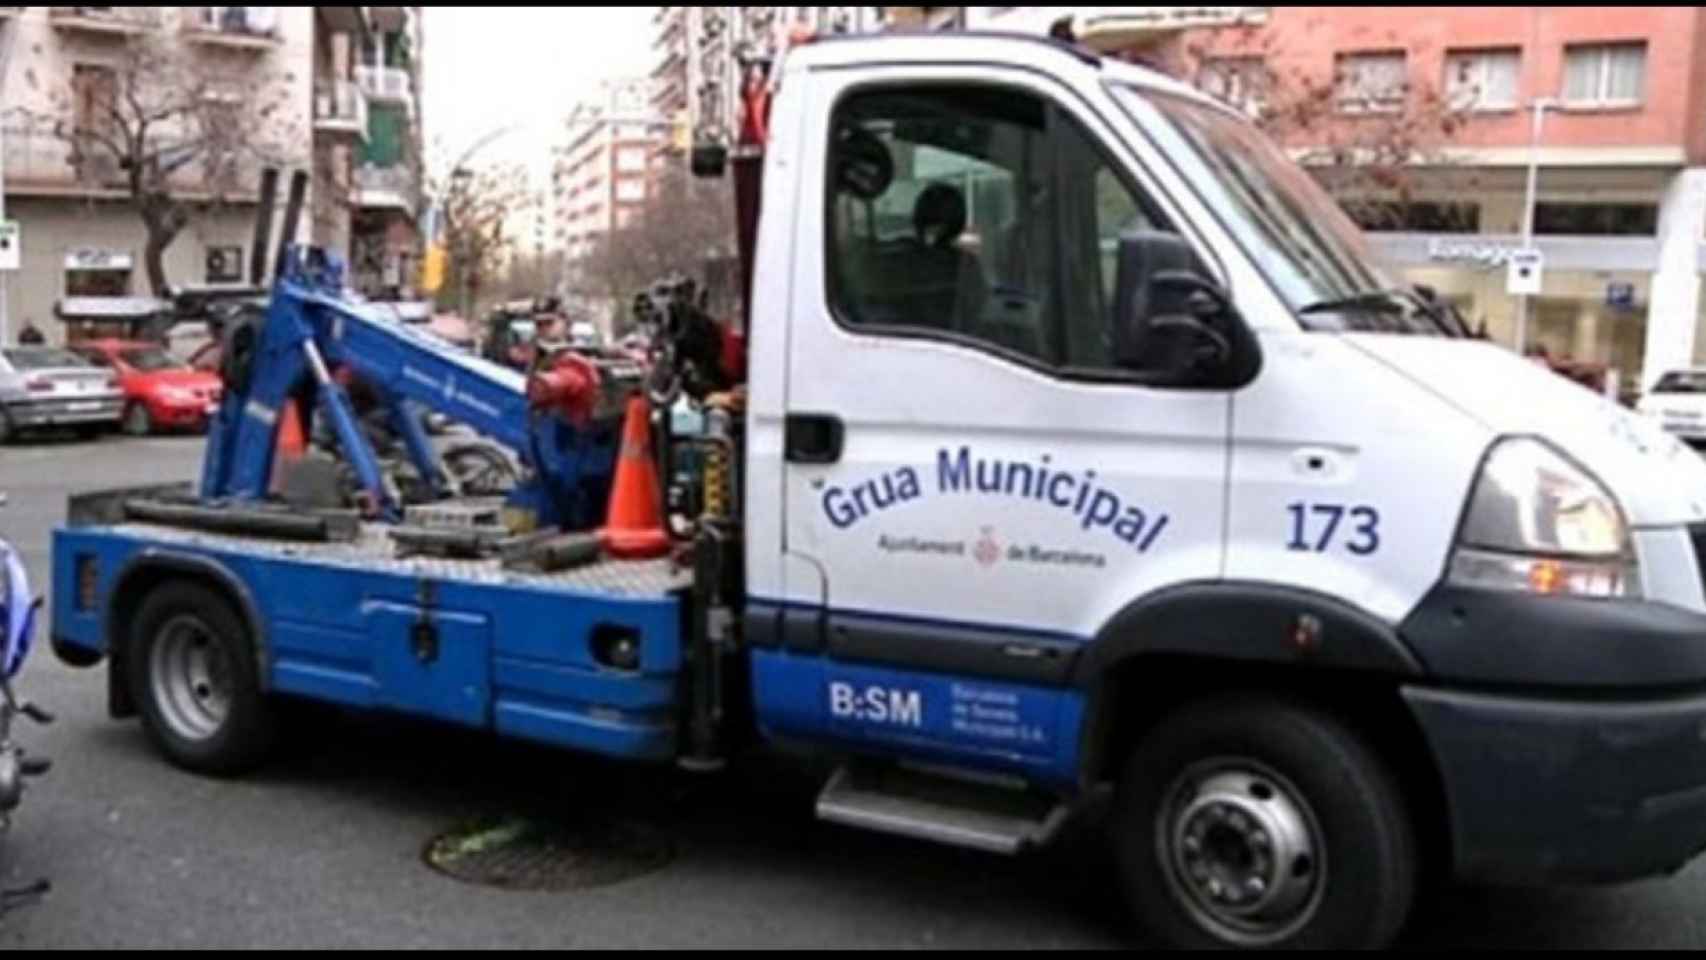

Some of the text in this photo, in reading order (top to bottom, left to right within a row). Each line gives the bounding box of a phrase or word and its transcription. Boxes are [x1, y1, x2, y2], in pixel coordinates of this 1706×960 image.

[822, 445, 1169, 552] Grua Municipal
[1286, 502, 1380, 556] 173
[1028, 544, 1106, 568] Barcelona
[830, 681, 922, 728] B:SM
